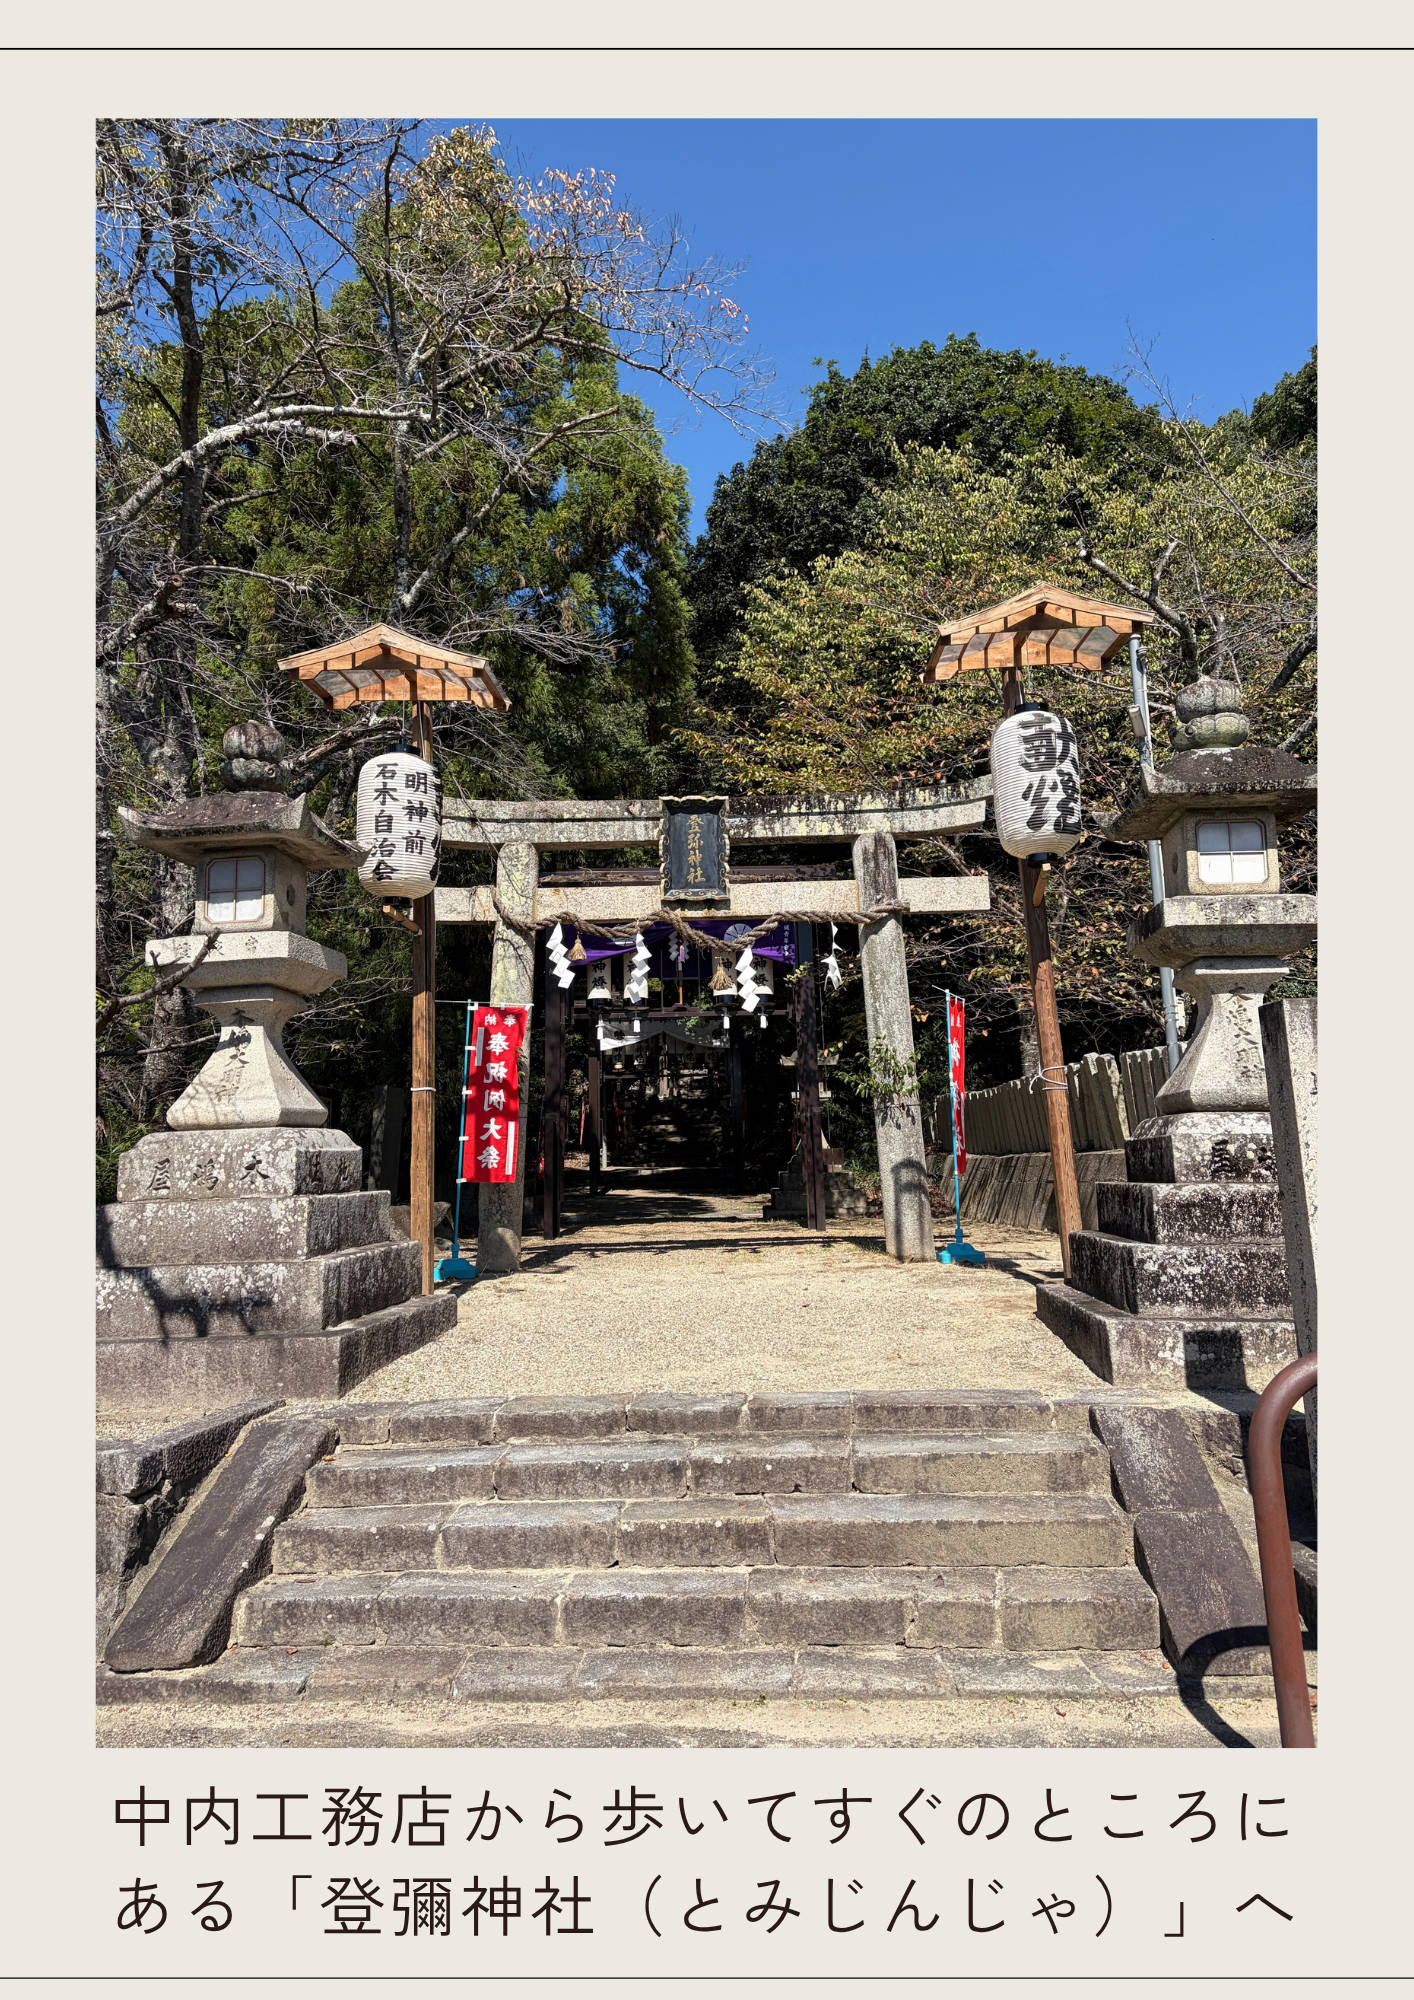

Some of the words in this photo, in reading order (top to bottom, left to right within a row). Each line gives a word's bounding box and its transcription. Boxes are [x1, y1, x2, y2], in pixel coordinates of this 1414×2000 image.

[371, 762, 400, 881] 石木自治会
[402, 771, 429, 856] 明神前
